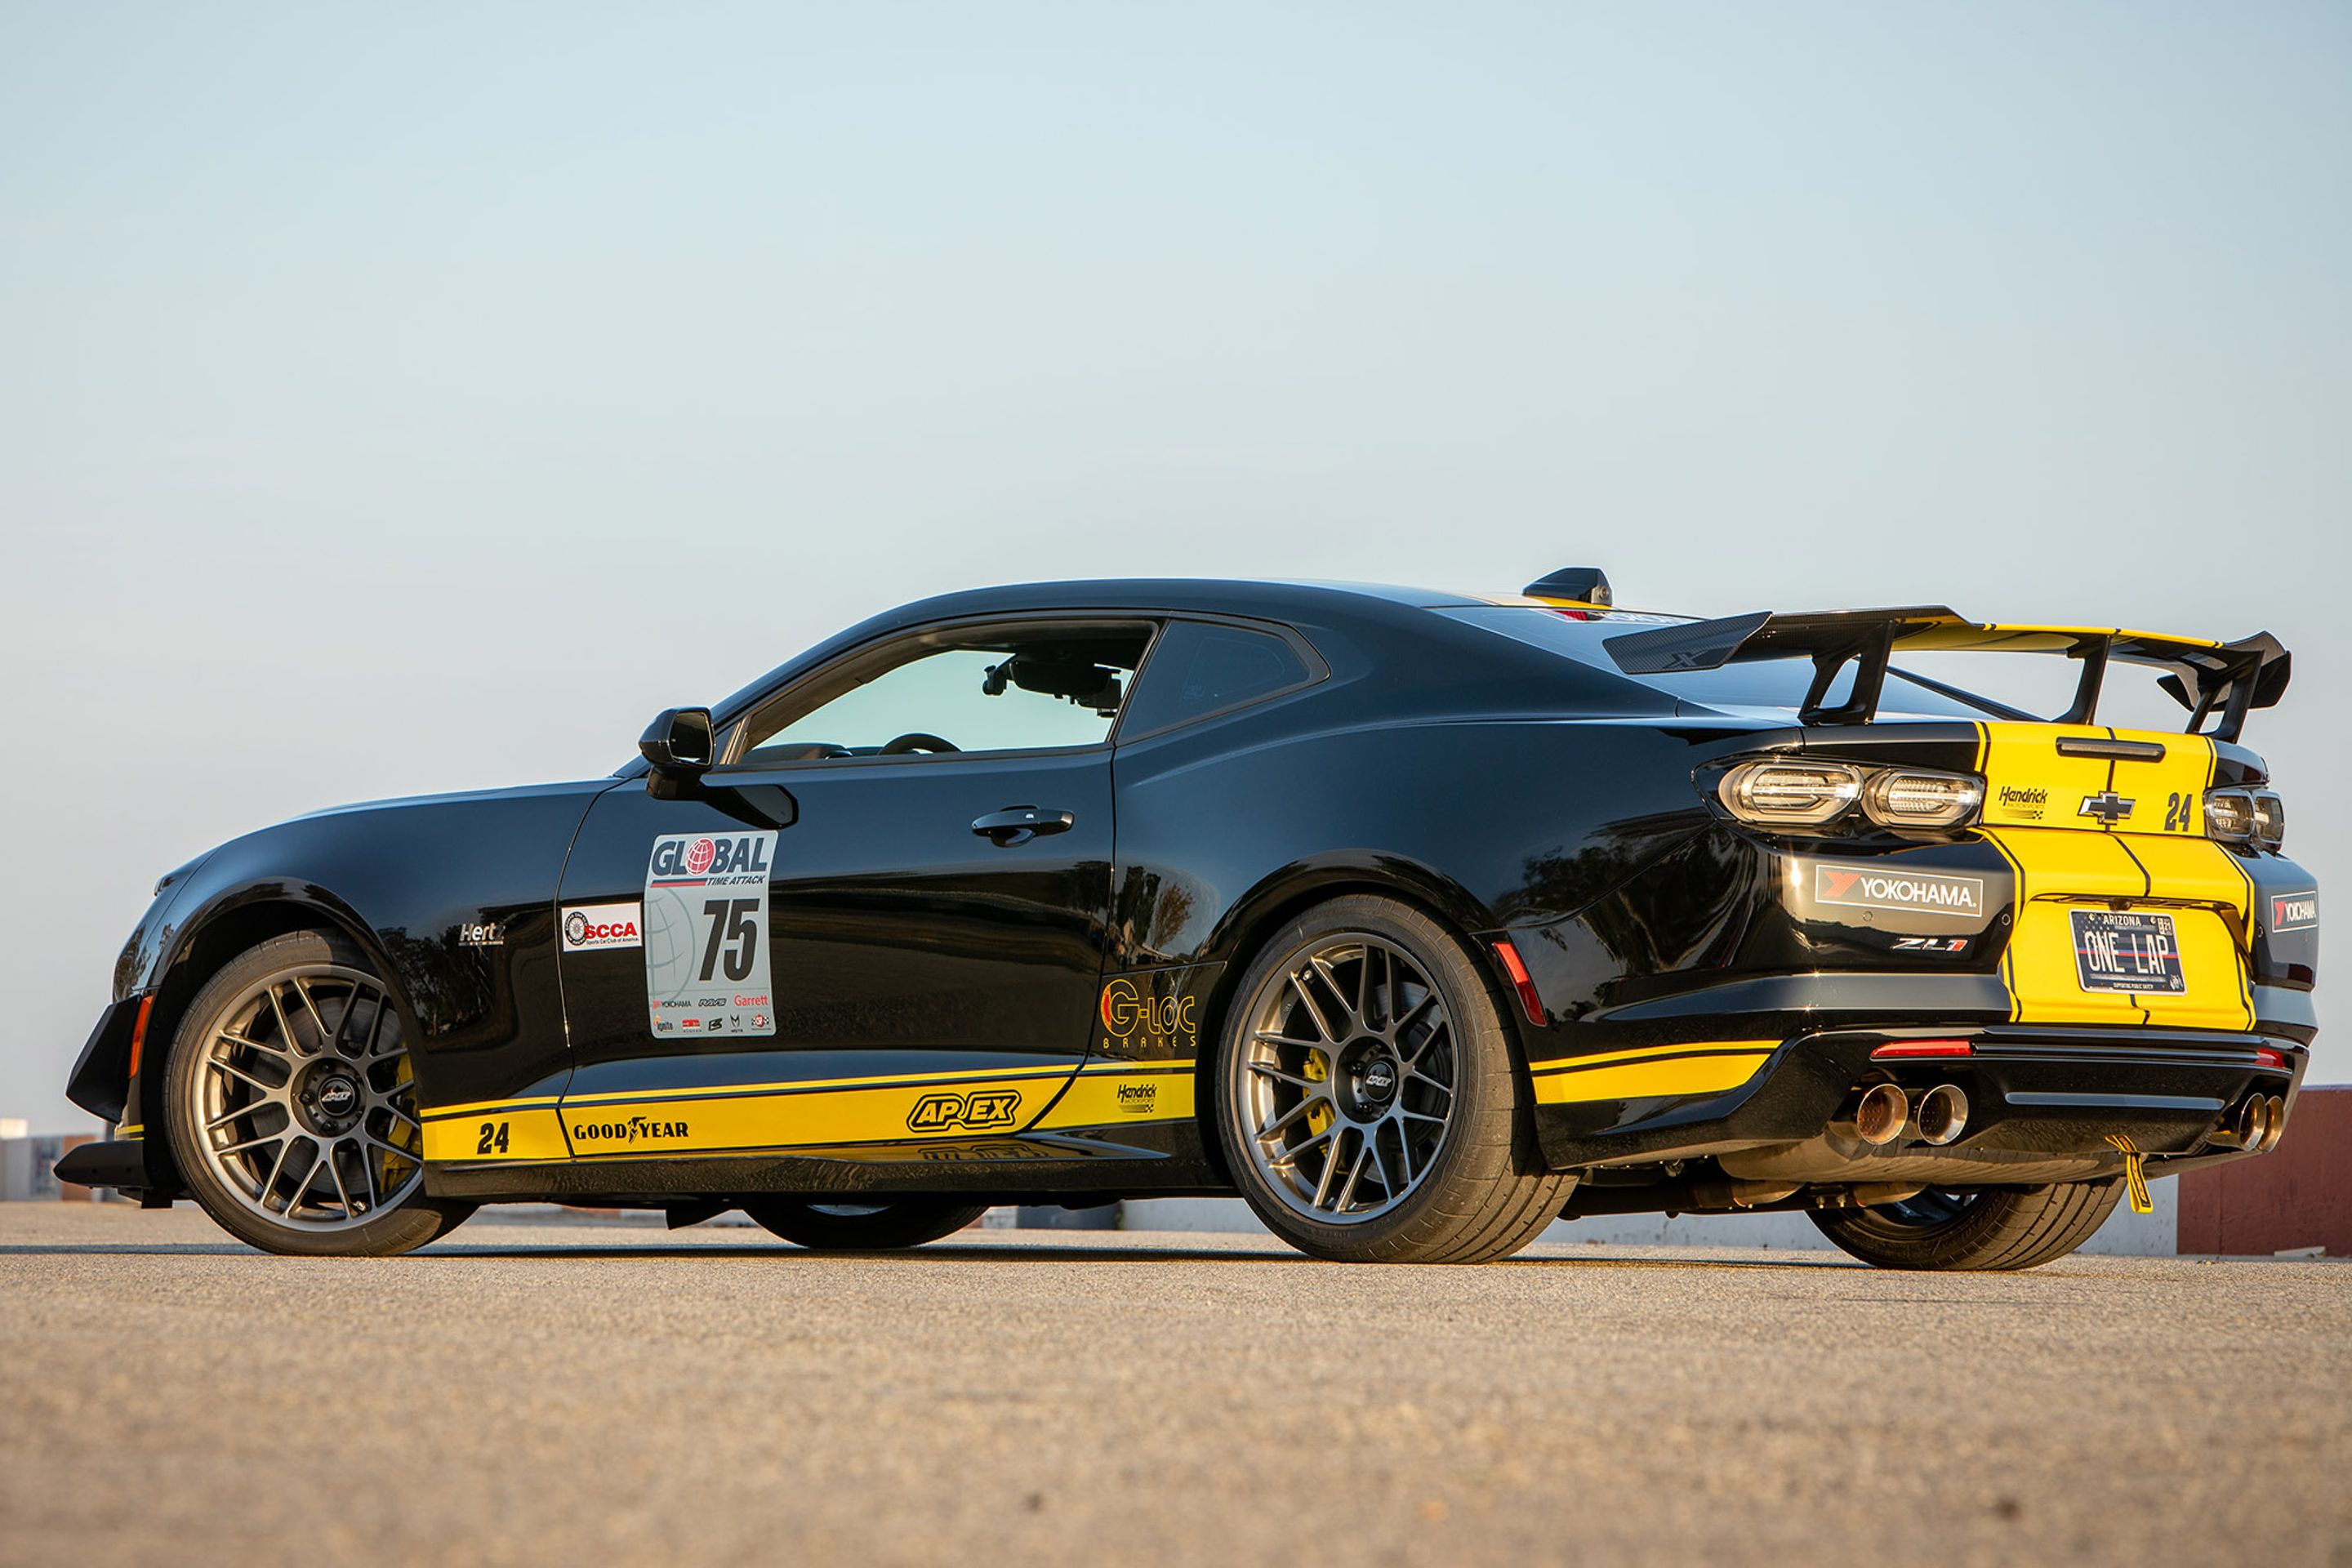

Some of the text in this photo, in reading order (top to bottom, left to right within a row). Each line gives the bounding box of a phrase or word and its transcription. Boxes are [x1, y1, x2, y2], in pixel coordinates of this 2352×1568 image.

[1998, 786, 2048, 806] Hendrick
[2163, 792, 2193, 831] 24
[652, 837, 768, 876] GLOBAL
[707, 875, 766, 886] TIME ATTACK
[2102, 914, 2141, 926] ARIZONA
[584, 921, 638, 939] SCCA
[698, 898, 760, 982] 75
[1891, 938, 1968, 951] ZL1
[2084, 930, 2169, 974] ONE LAP
[733, 994, 768, 1007] Garrett
[1102, 1036, 1196, 1049] BRAKES
[1117, 1084, 1157, 1103] Hendrick
[911, 1093, 1017, 1129] APEX
[477, 1122, 510, 1154] 24
